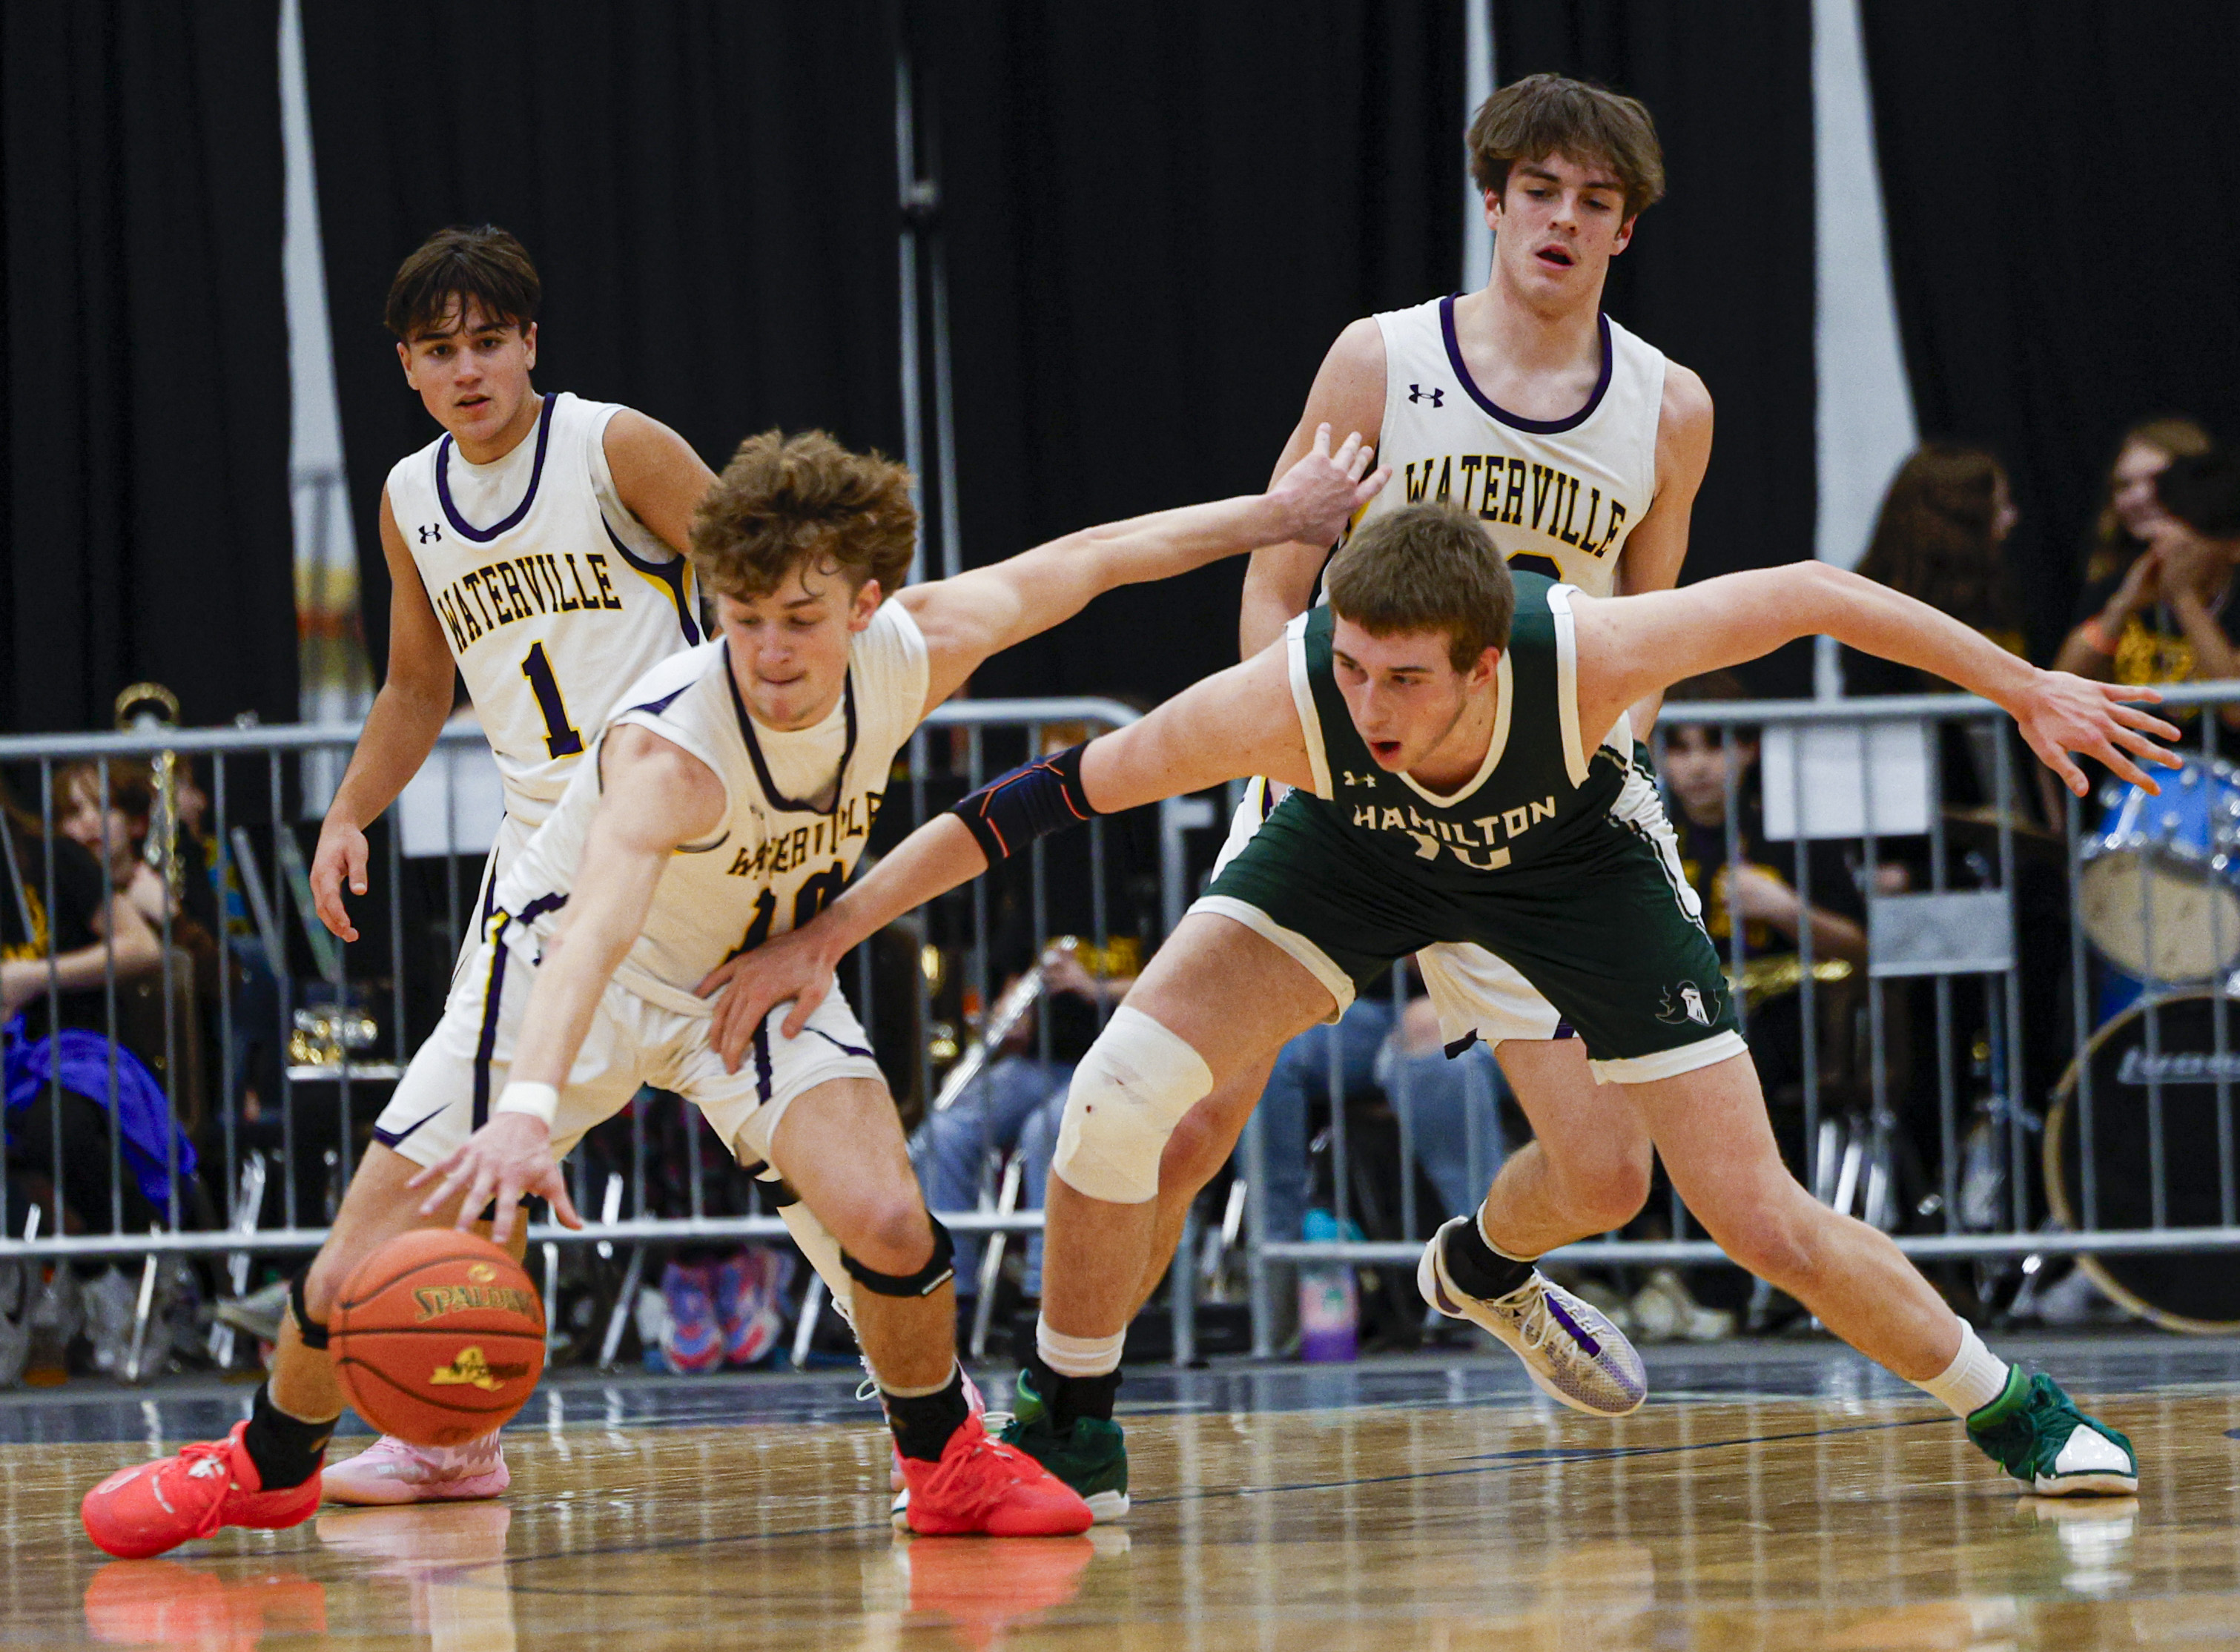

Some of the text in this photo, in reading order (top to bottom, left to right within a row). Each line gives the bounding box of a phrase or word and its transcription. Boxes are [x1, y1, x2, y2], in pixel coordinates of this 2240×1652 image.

[1405, 455, 1627, 559] WATERVILLE
[437, 553, 621, 655] WATERVILLE
[521, 638, 587, 760] 1
[1353, 796, 1556, 847] HAMILTON
